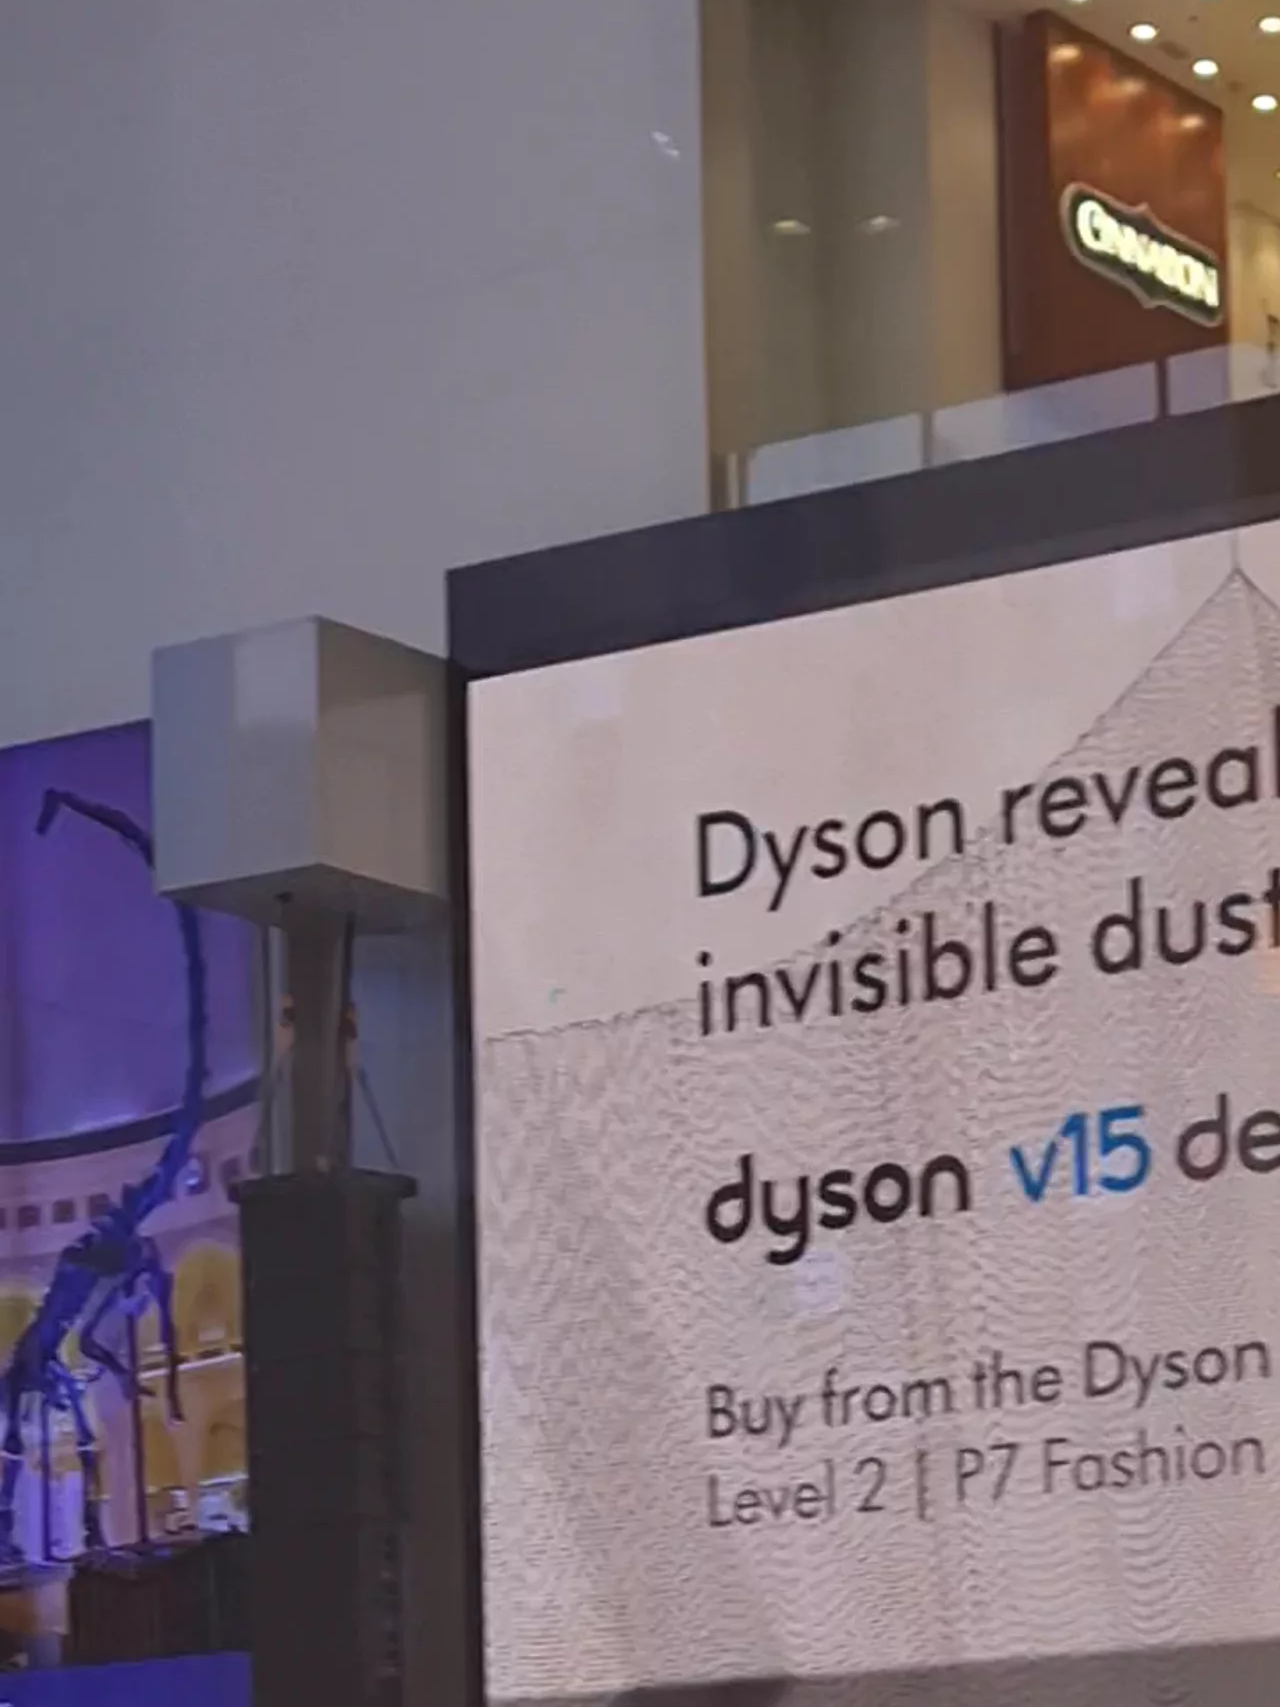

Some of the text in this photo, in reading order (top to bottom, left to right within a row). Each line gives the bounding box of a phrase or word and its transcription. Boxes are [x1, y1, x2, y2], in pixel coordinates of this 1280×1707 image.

[695, 796, 967, 912] Dyson
[697, 902, 1059, 1035] invisible
[704, 1153, 971, 1265] dyson
[1009, 1106, 1151, 1203] v15
[706, 1384, 803, 1449] Buy
[822, 1367, 953, 1427] from
[970, 1350, 1063, 1410] the
[1084, 1338, 1271, 1410] Dyson
[709, 1458, 836, 1528] Level
[854, 1456, 885, 1513] 2
[956, 1443, 1018, 1502] P7
[1042, 1424, 1265, 1493] Fashion
